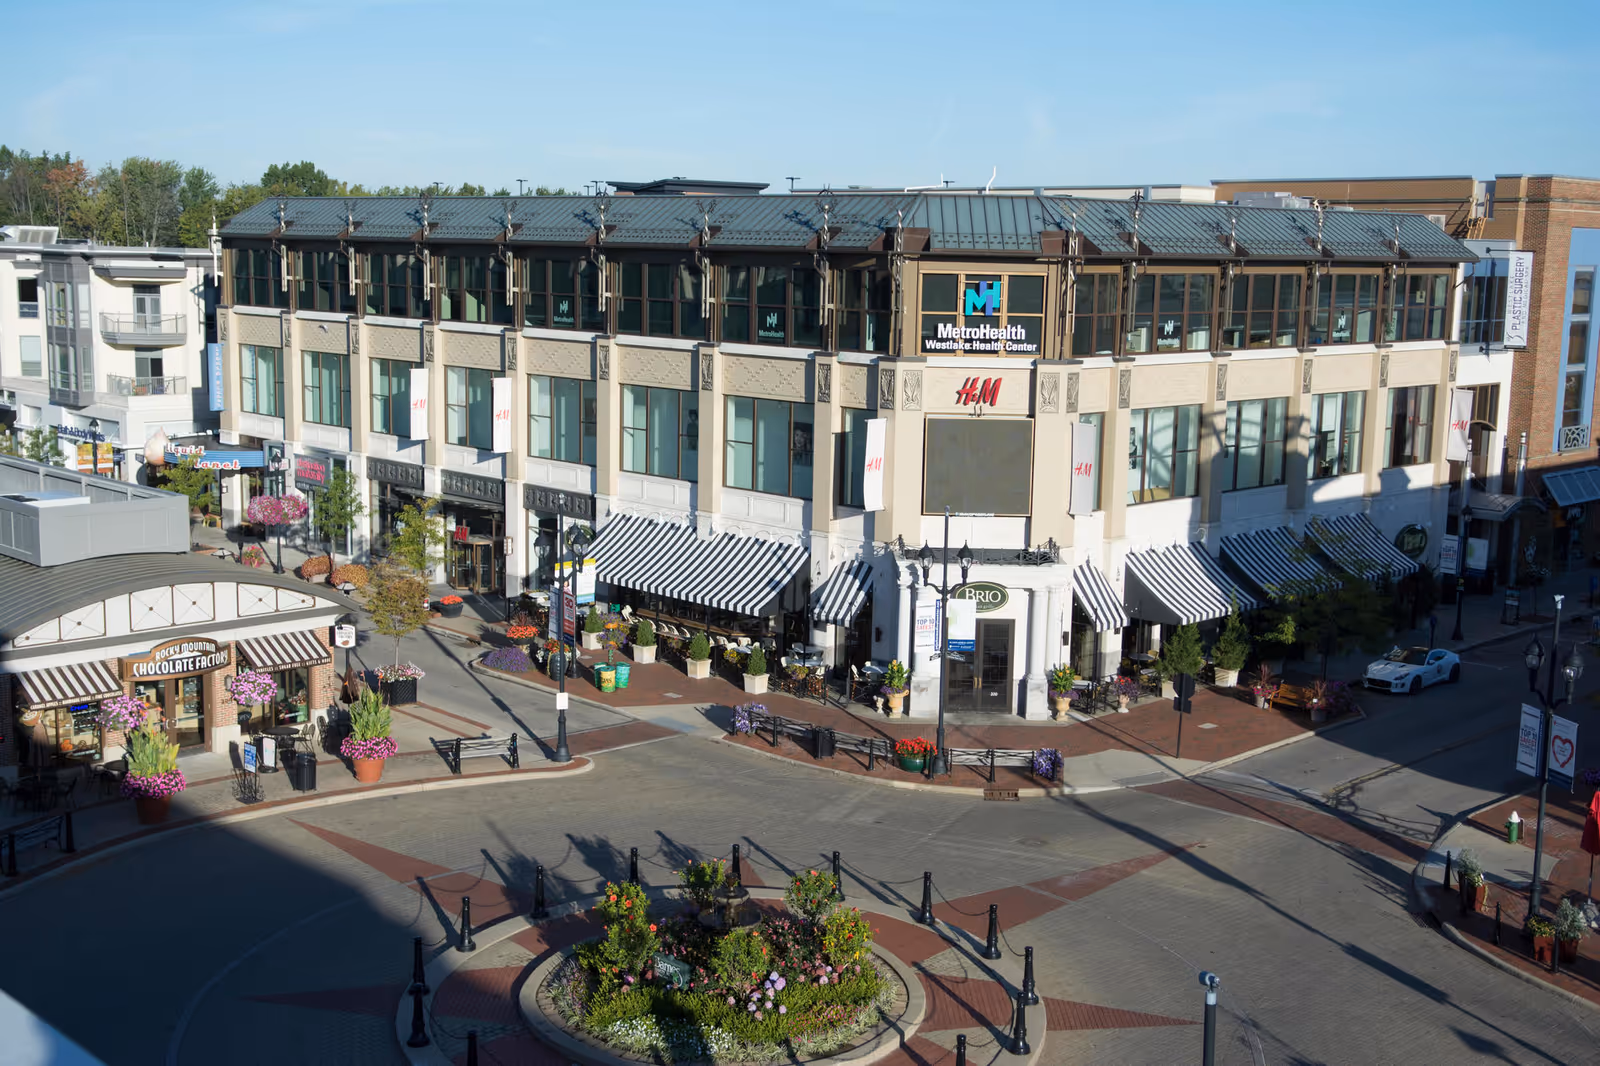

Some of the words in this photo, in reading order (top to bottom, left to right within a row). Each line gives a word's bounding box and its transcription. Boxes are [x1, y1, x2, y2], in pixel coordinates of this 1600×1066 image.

[1514, 256, 1525, 295] SURGERY
[1511, 296, 1523, 331] PLASTIC
[937, 322, 1026, 340] MetroHealth
[925, 339, 971, 351] Westlake
[972, 340, 1004, 351] Health
[1005, 341, 1038, 352] Center
[955, 376, 1003, 407] H&M
[165, 442, 206, 456] liquid
[190, 457, 241, 470] lanet
[965, 588, 1001, 603] BRIO
[155, 645, 180, 661] ROCKY
[181, 641, 216, 653] MOUNTAIN
[133, 656, 194, 677] CHOCOLATE
[195, 649, 228, 670] FACTORY
